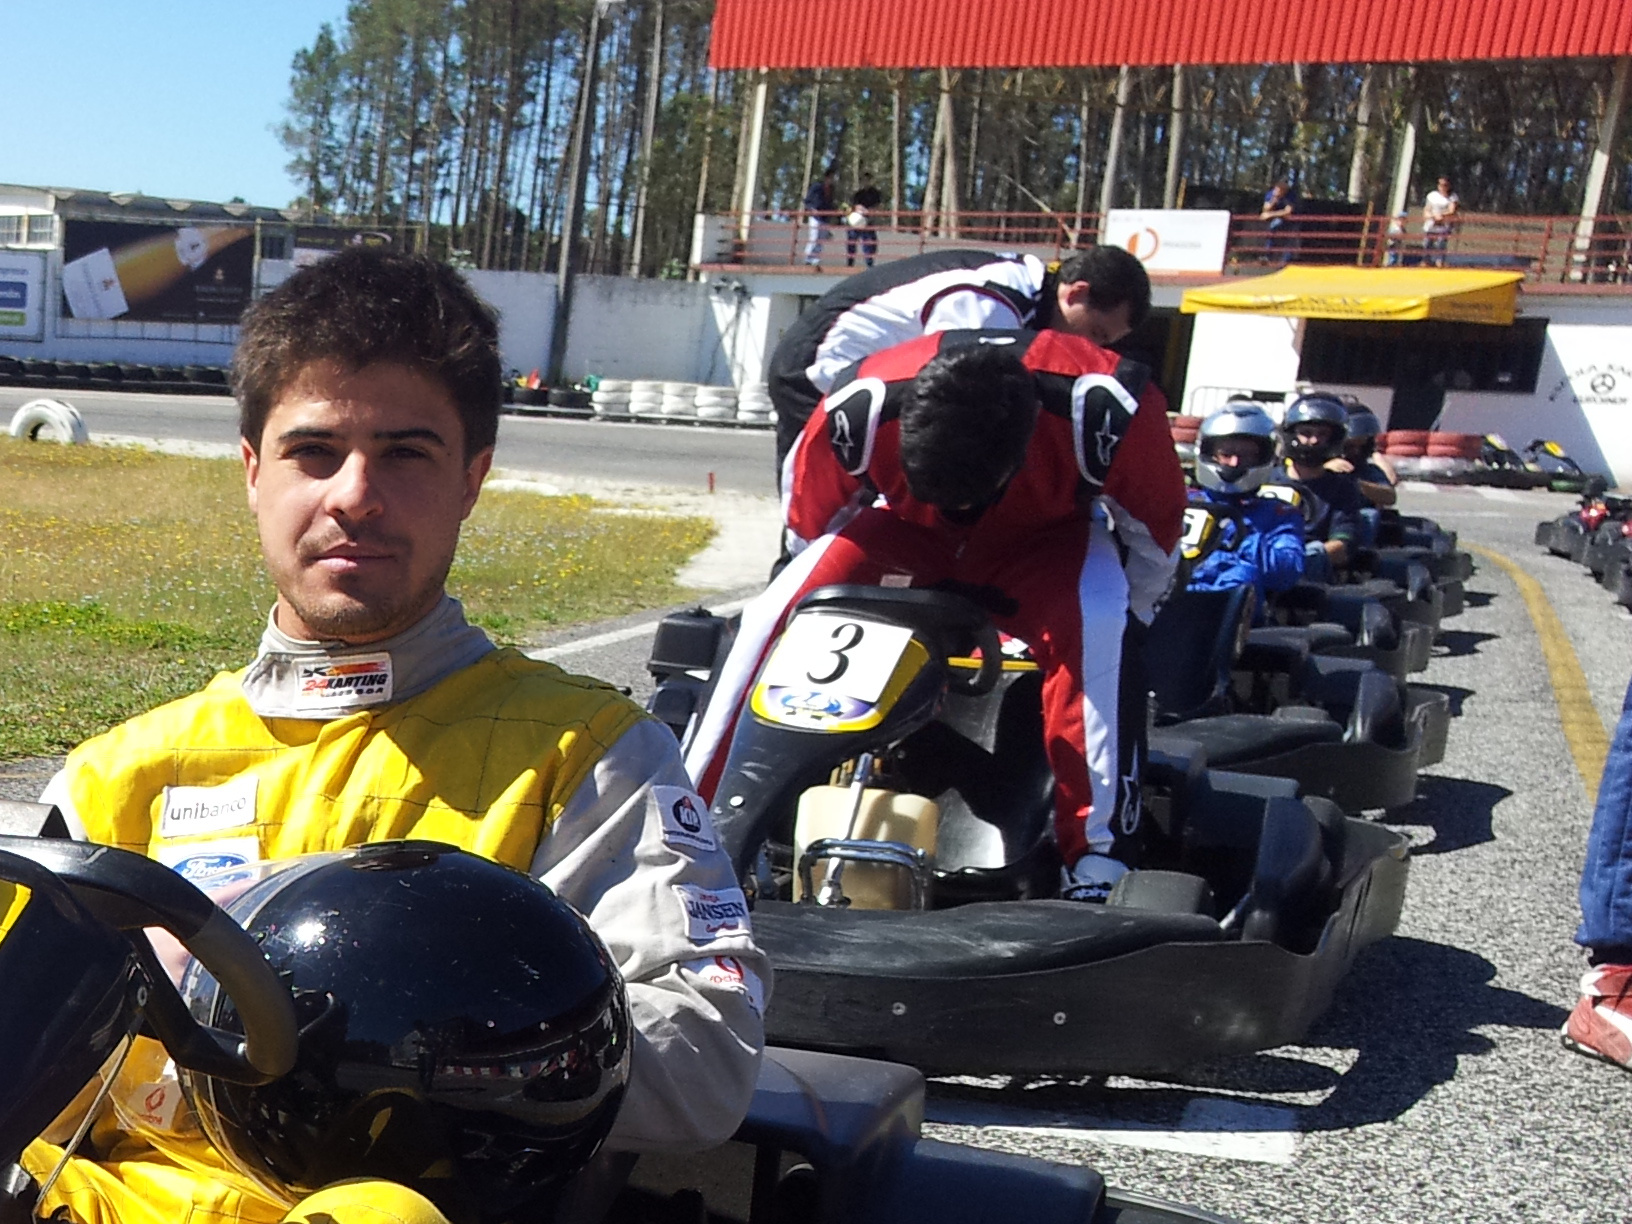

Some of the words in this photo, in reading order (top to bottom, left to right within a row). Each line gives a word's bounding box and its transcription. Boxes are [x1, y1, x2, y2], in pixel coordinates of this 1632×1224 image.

[805, 621, 866, 685] 3
[170, 796, 247, 821] unibanco
[687, 900, 746, 921] JANSEN
